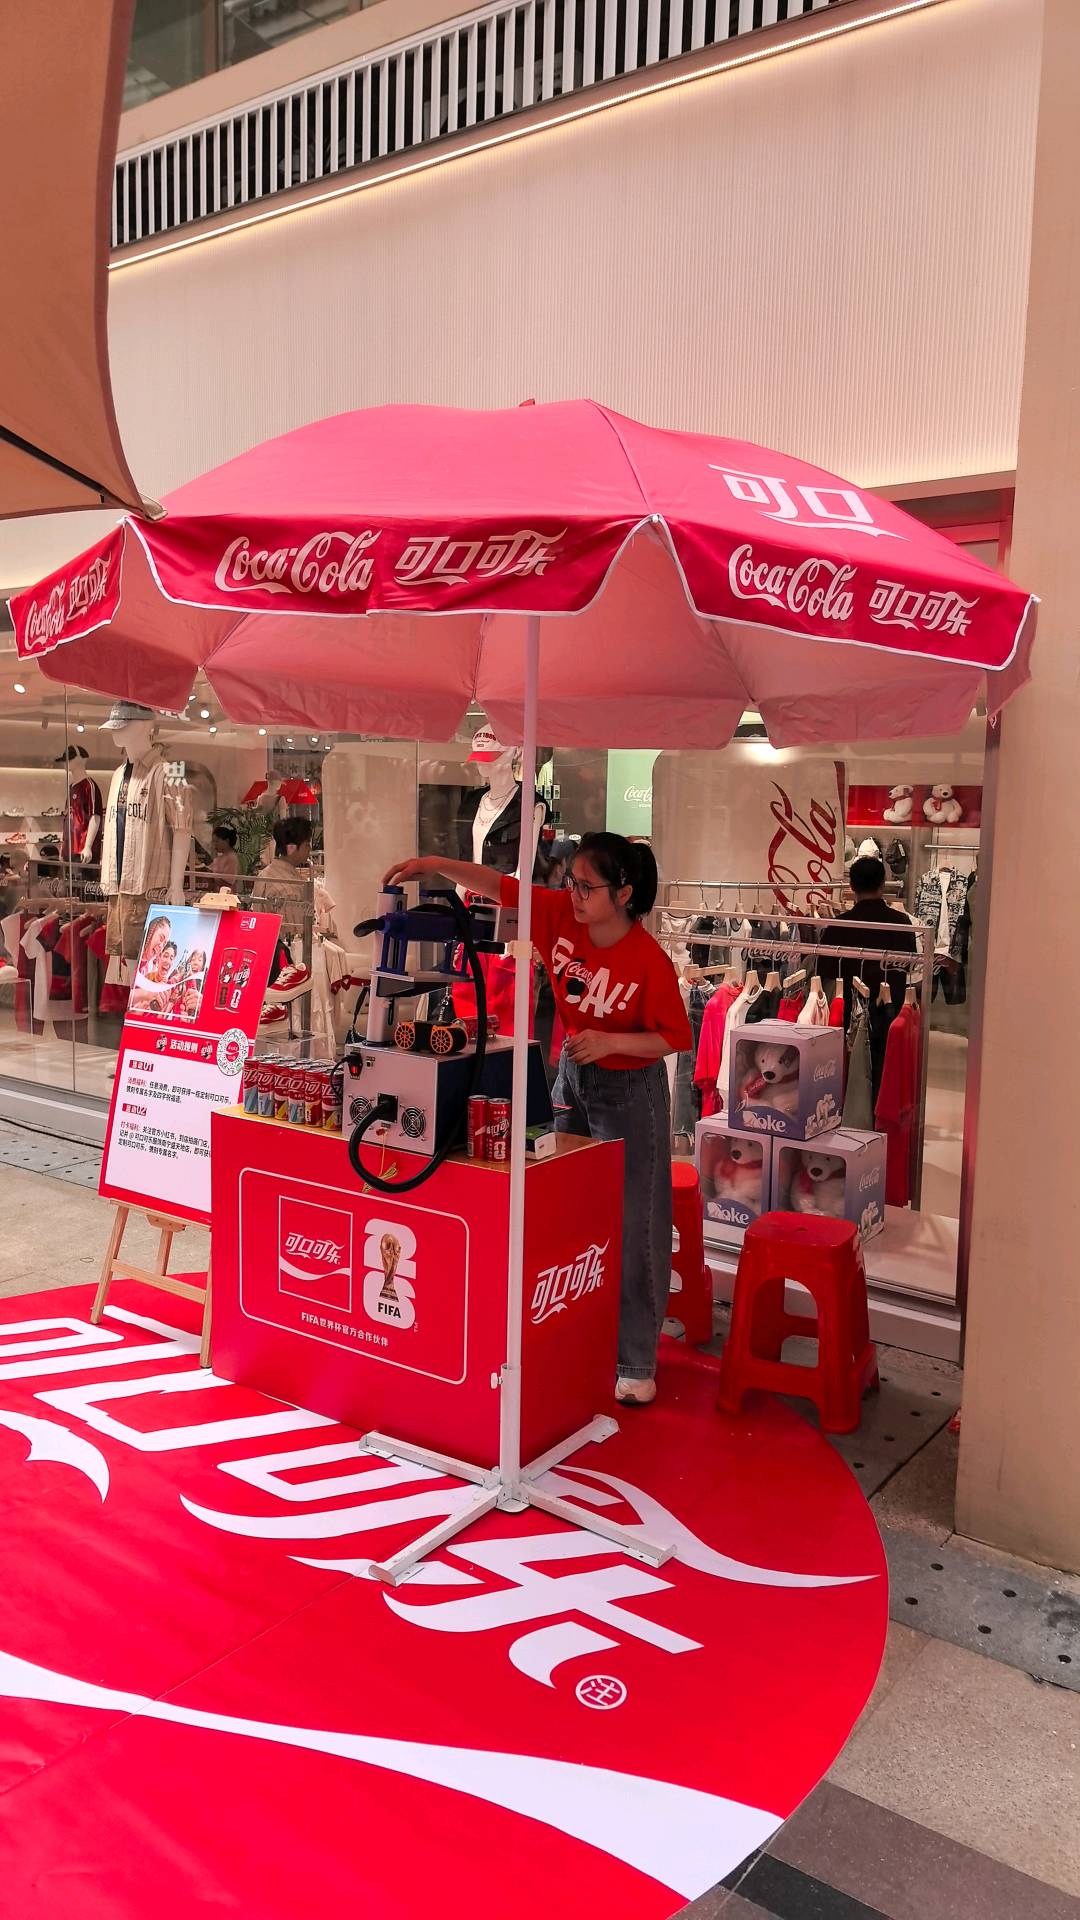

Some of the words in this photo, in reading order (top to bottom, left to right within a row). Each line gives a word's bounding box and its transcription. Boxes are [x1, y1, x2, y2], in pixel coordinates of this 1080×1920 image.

[66, 551, 112, 621] 可口可乐
[214, 530, 382, 595] Coca-Cola
[394, 527, 569, 586] 可口可乐
[727, 543, 858, 622] Coca-Cola
[868, 578, 982, 637] 可口可乐
[285, 1231, 345, 1265] 可口可乐
[530, 1237, 610, 1325] 可口可乐
[377, 1302, 402, 1320] FIFA
